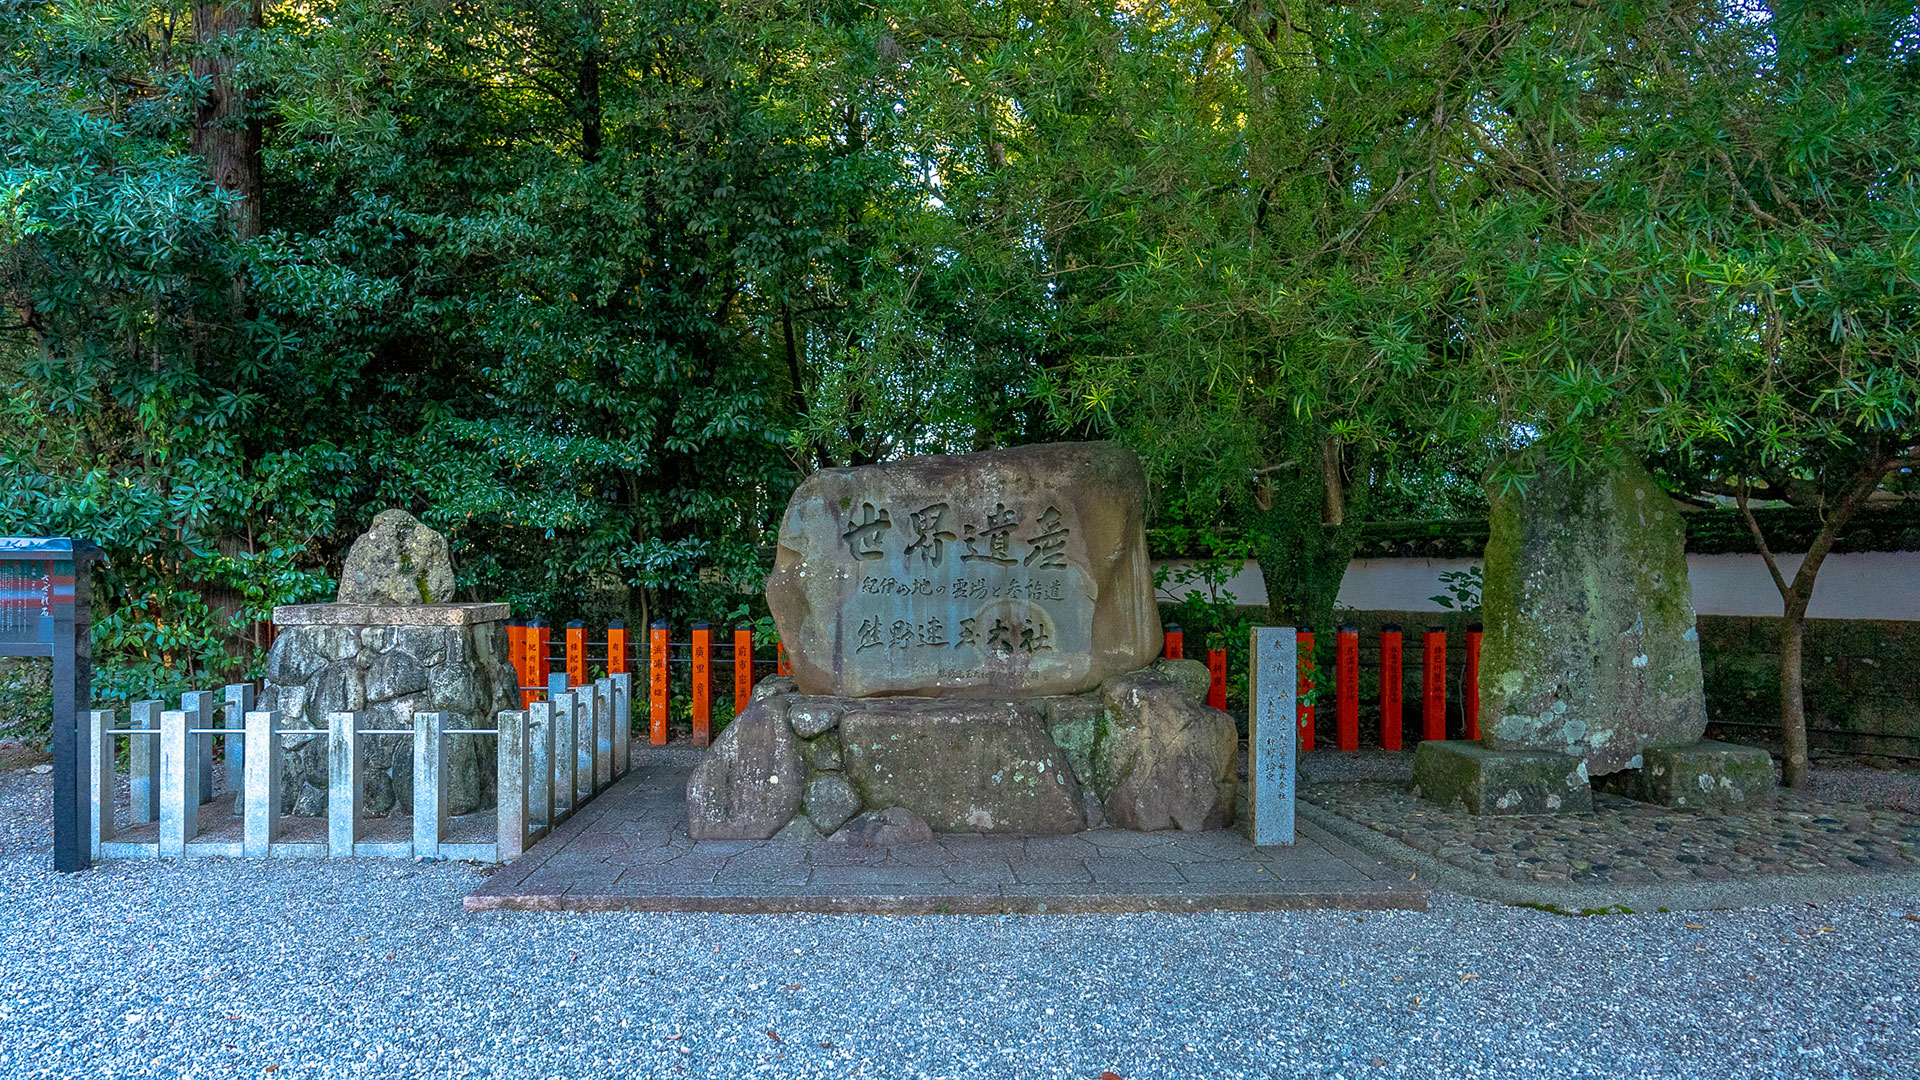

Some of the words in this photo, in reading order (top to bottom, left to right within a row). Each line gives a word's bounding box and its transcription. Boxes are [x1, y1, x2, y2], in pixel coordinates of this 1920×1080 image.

[842, 502, 1070, 570] 世界遺産
[40, 574, 51, 617] さざれ石
[855, 614, 1053, 654] 熊野速玉大社
